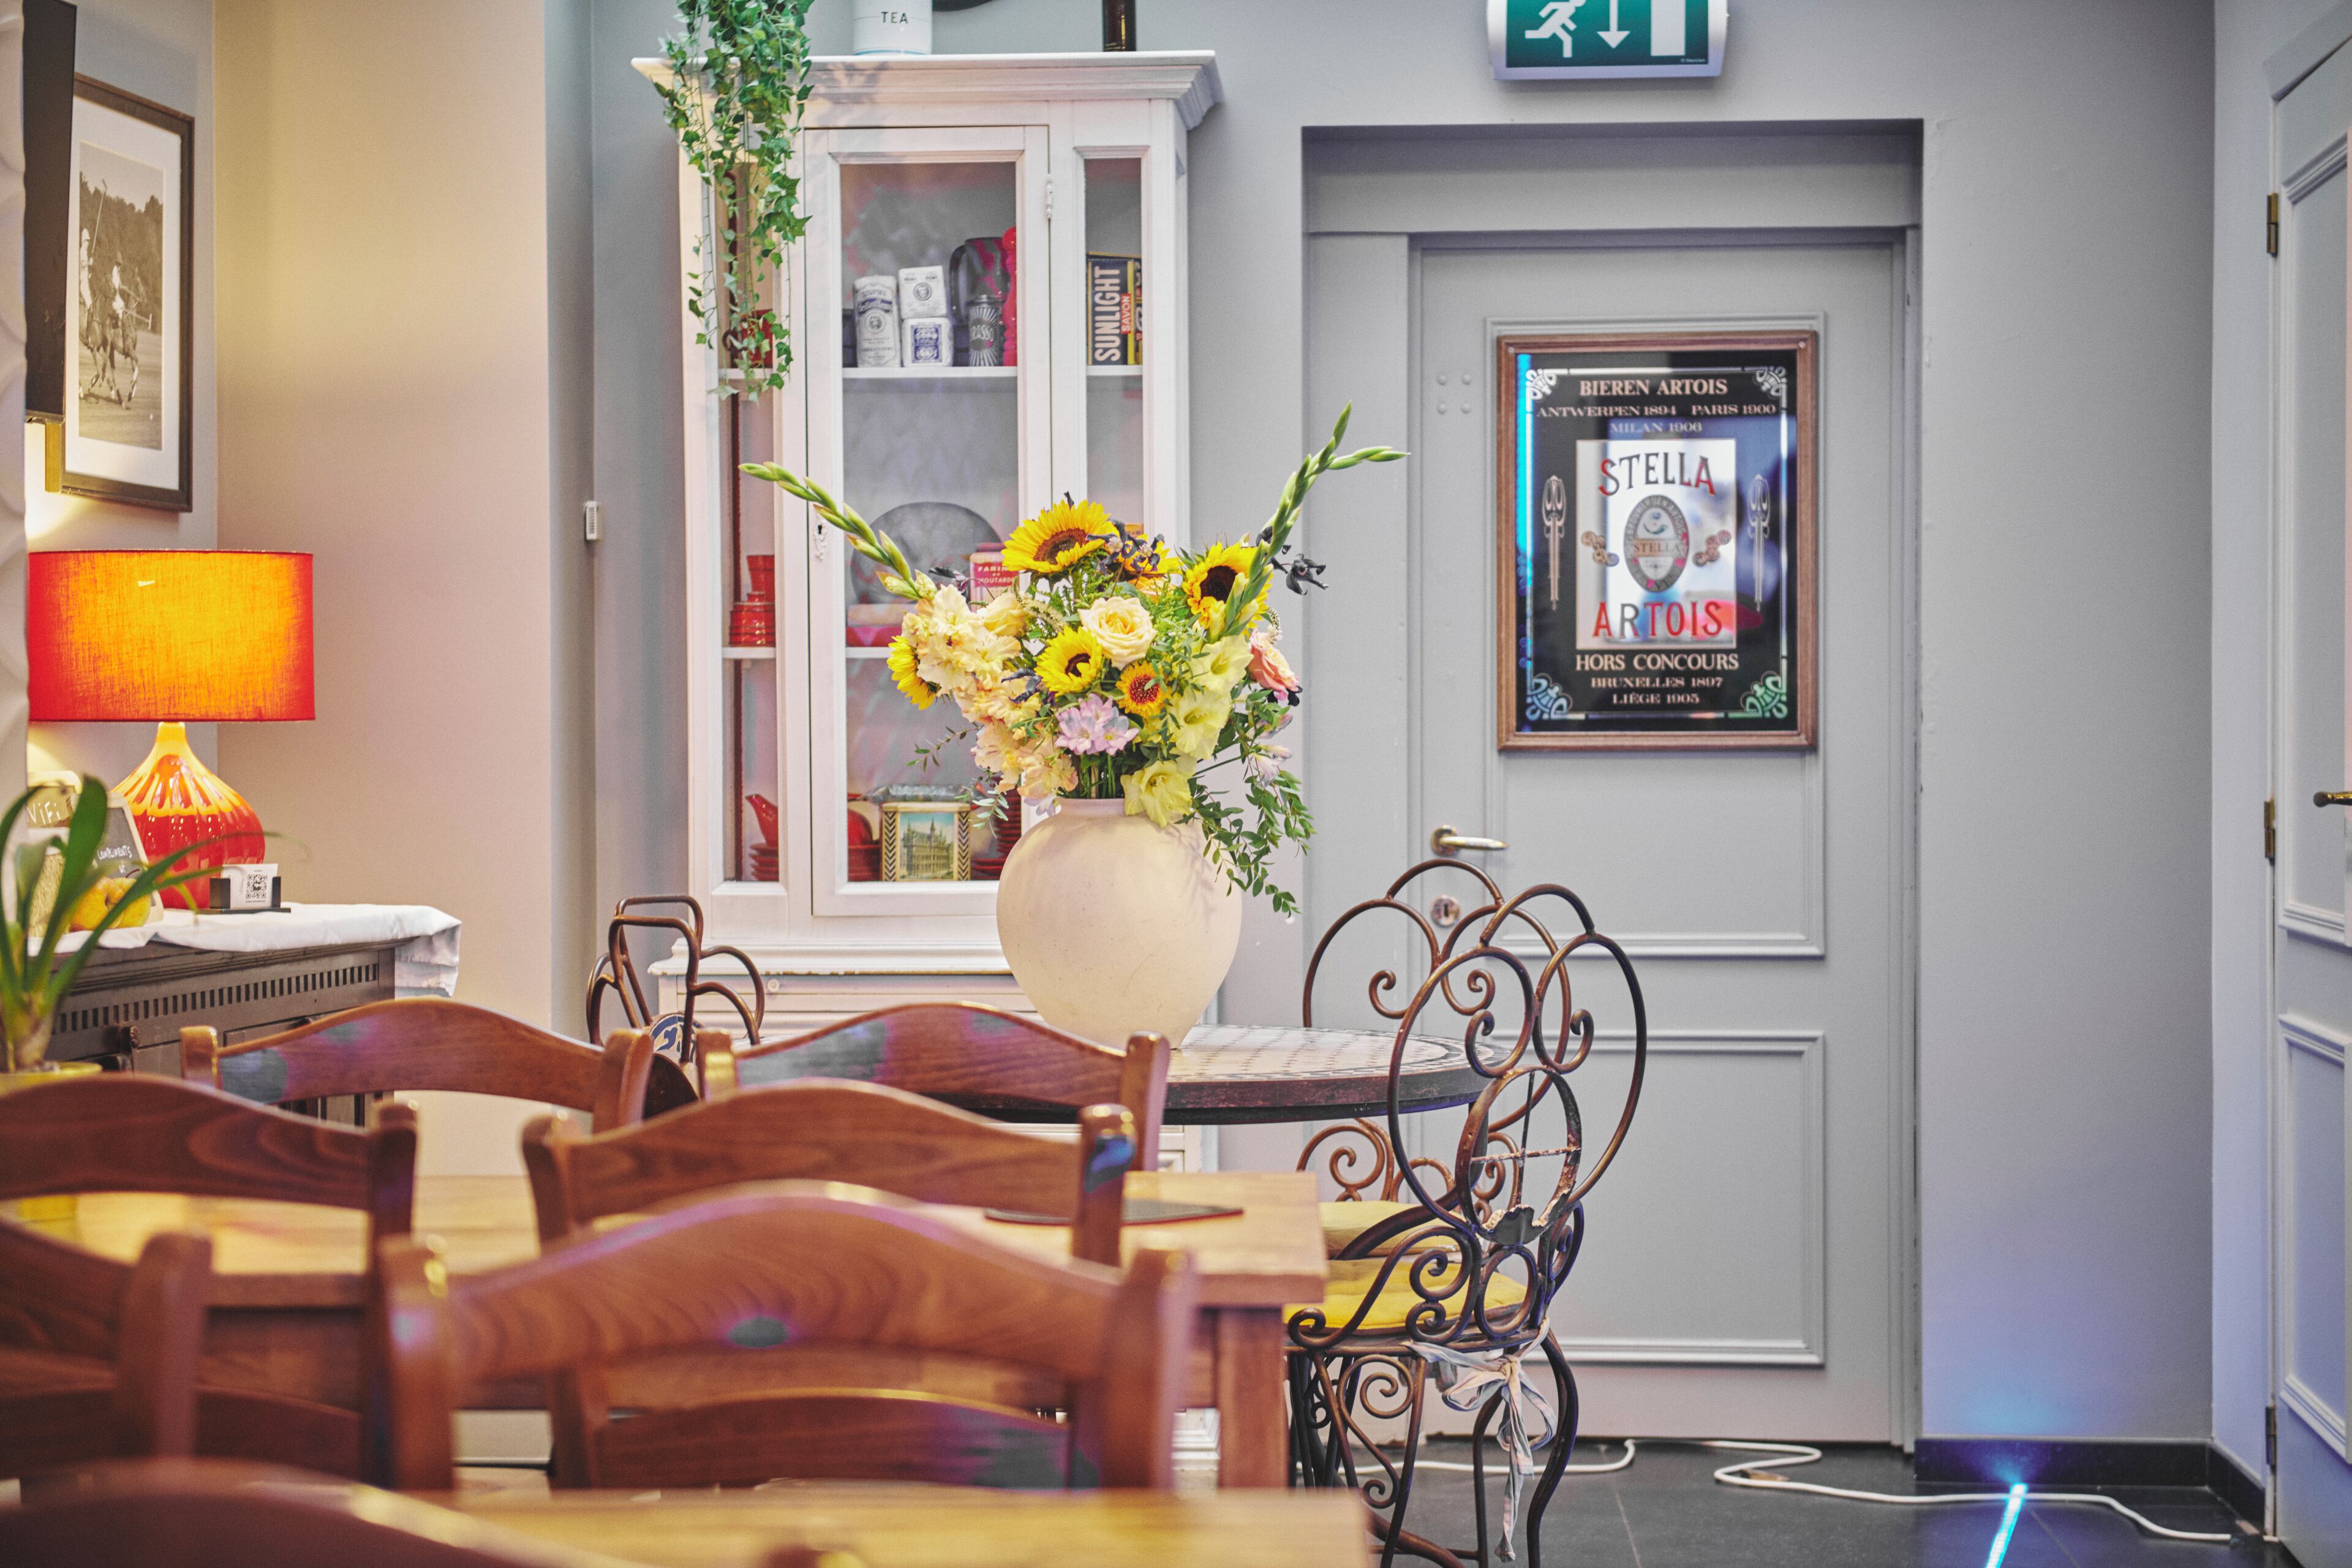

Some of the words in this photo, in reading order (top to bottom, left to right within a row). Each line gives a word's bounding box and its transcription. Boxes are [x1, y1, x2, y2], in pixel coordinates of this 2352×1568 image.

[881, 12, 908, 23] TEA
[1094, 265, 1121, 362] SUNLIGHT
[1121, 295, 1131, 332] SAVON
[1579, 379, 1650, 396] BIEREN
[1656, 379, 1728, 396] ARTOIS
[1537, 405, 1641, 417] ANTWERPEN
[1643, 405, 1676, 416] 1894
[1691, 404, 1739, 415] PARIS
[1742, 404, 1776, 415] 1900
[1610, 422, 1664, 432] MILAN
[1668, 421, 1703, 432] 1906
[1598, 451, 1716, 497] STELLA
[1593, 600, 1722, 638] ARTOIS
[1575, 654, 1626, 671] HORS
[1633, 653, 1740, 671] CONCOURS
[1591, 677, 1686, 688] BRUXELLES
[1665, 693, 1700, 704] 1905
